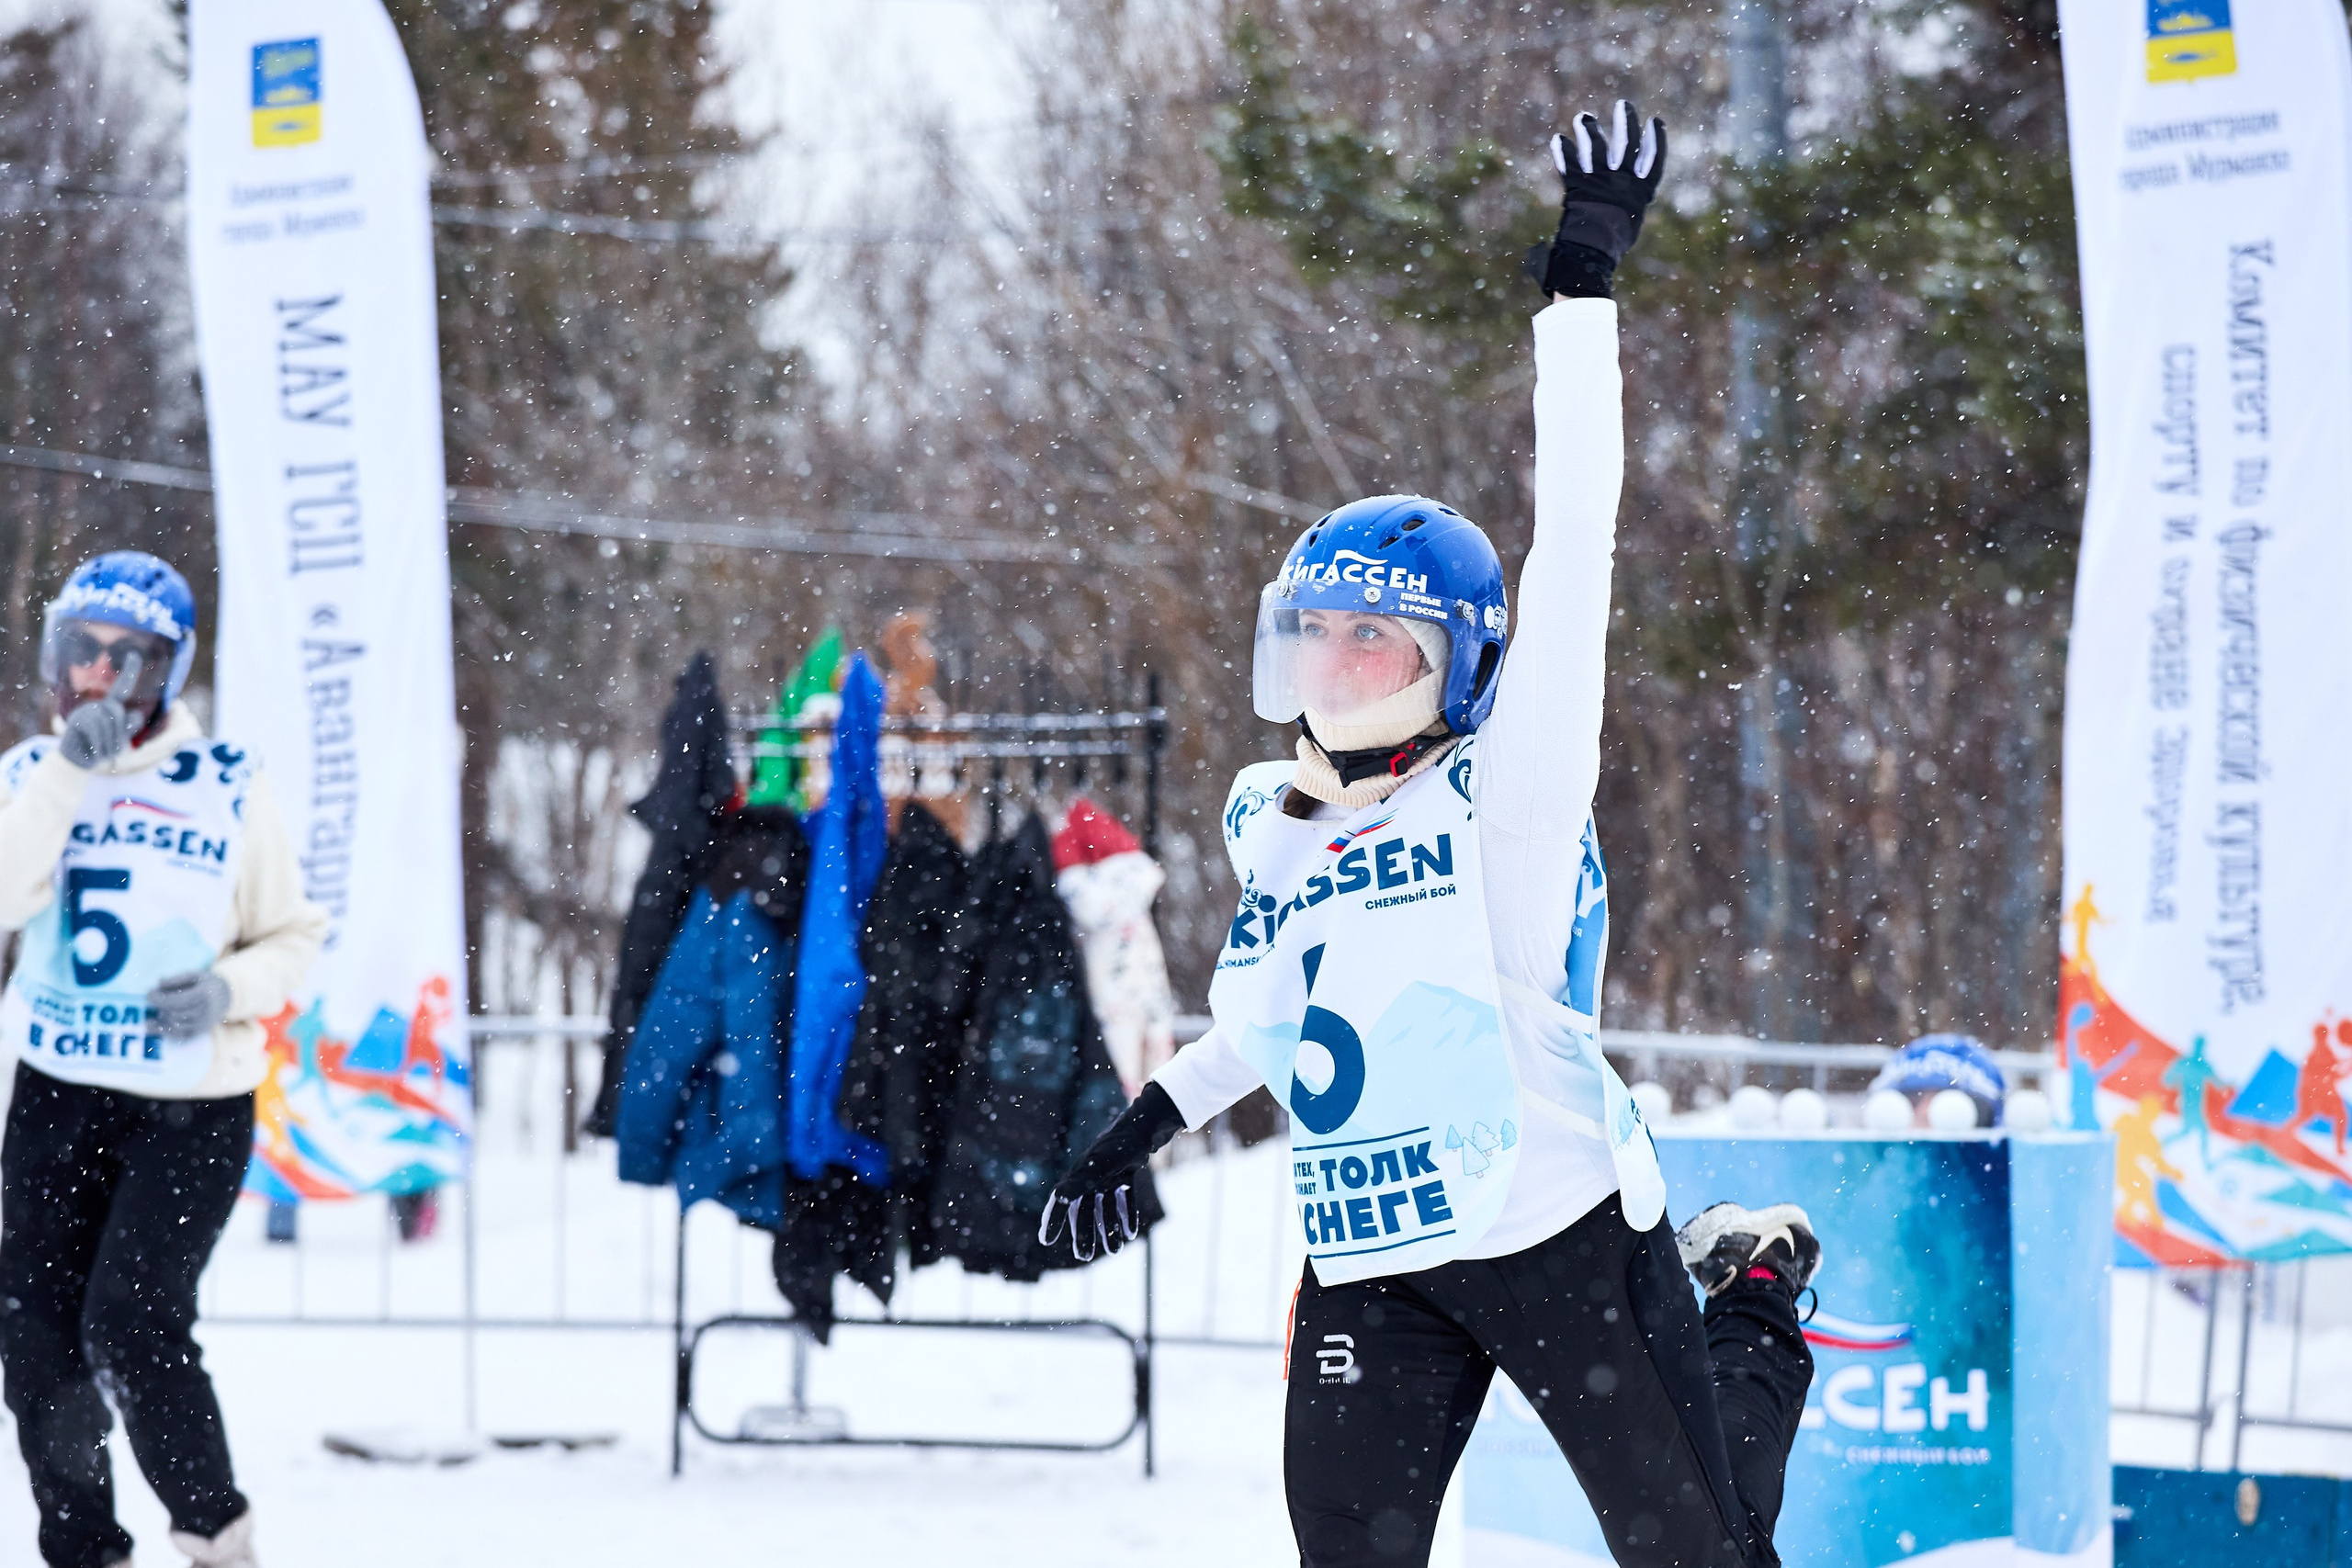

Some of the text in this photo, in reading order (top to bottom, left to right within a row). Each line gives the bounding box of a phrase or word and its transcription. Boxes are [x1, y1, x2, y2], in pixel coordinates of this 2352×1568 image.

[276, 292, 351, 426] МАУ
[2227, 239, 2276, 438] Комитет
[2152, 343, 2199, 495] спорту
[2231, 457, 2268, 507] по
[2161, 513, 2198, 542] и
[1398, 603, 1448, 620] В РОССИИ
[1400, 592, 1442, 607] ПЕРВЫЕ
[71, 821, 226, 863] GASSEN
[1365, 884, 1457, 910] СНЕЖНЫЙ БОЙ
[69, 868, 130, 987] 5
[1319, 1140, 1440, 1191] ТОЛК
[1304, 1179, 1453, 1245] СНЕГЕ
